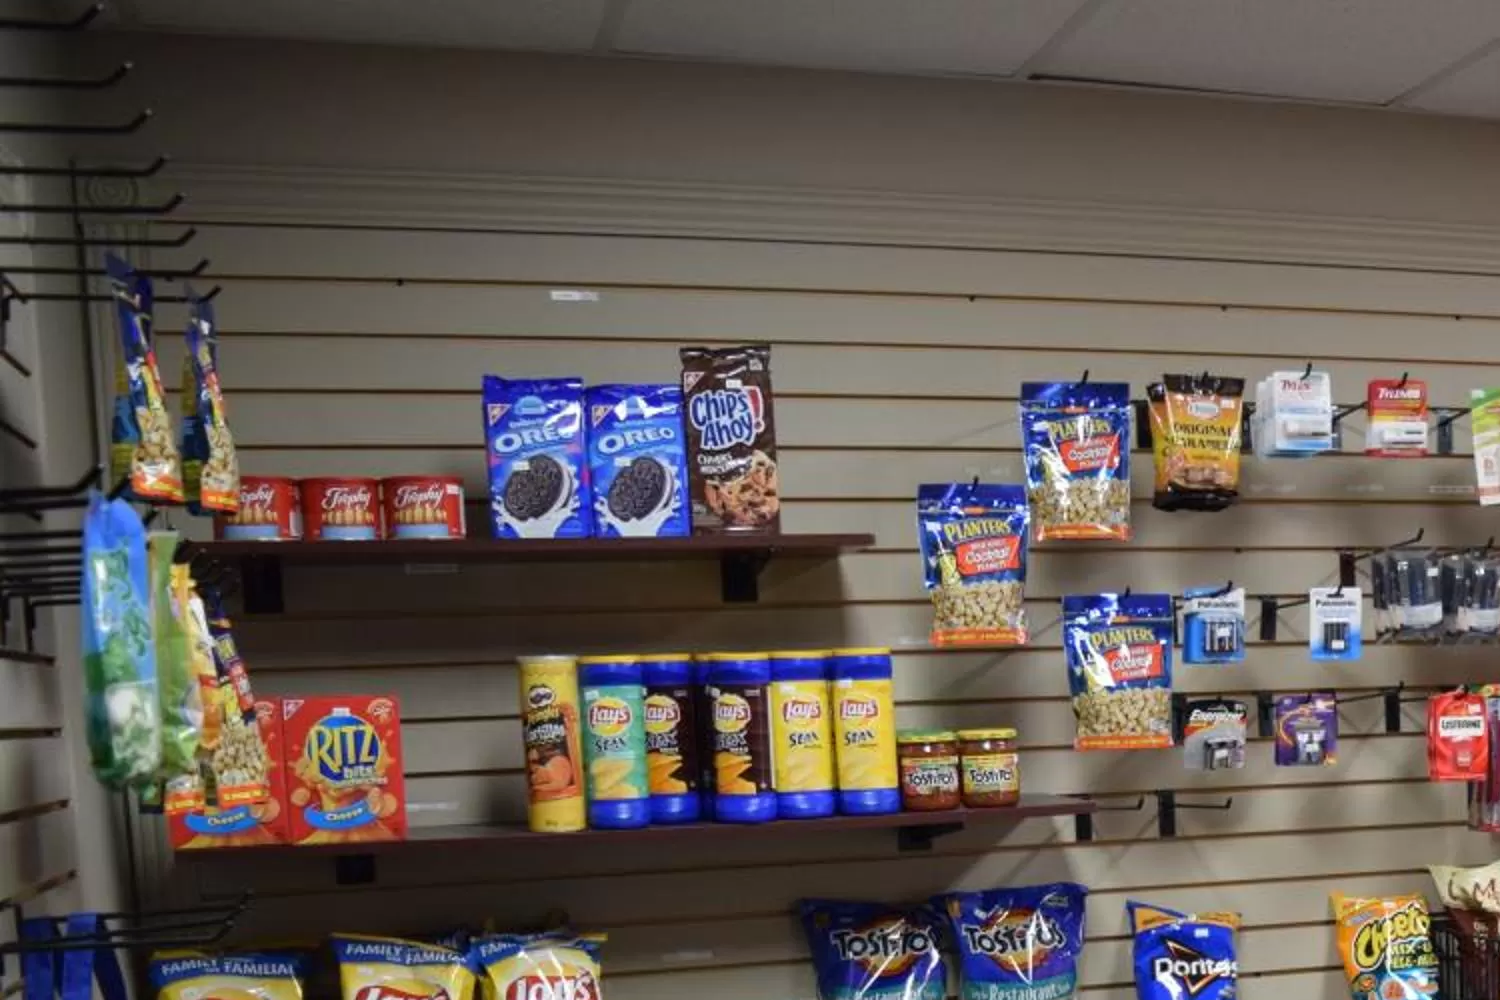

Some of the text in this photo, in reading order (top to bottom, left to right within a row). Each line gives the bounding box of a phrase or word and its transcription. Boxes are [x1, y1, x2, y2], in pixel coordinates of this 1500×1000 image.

[691, 390, 749, 427] Chips
[599, 427, 674, 453] OREO
[321, 485, 372, 509] Trophy
[394, 483, 445, 508] Trophy
[943, 519, 1011, 542] PLANTERS
[1090, 628, 1156, 648] PLANTERS
[308, 723, 378, 777] RITZ
